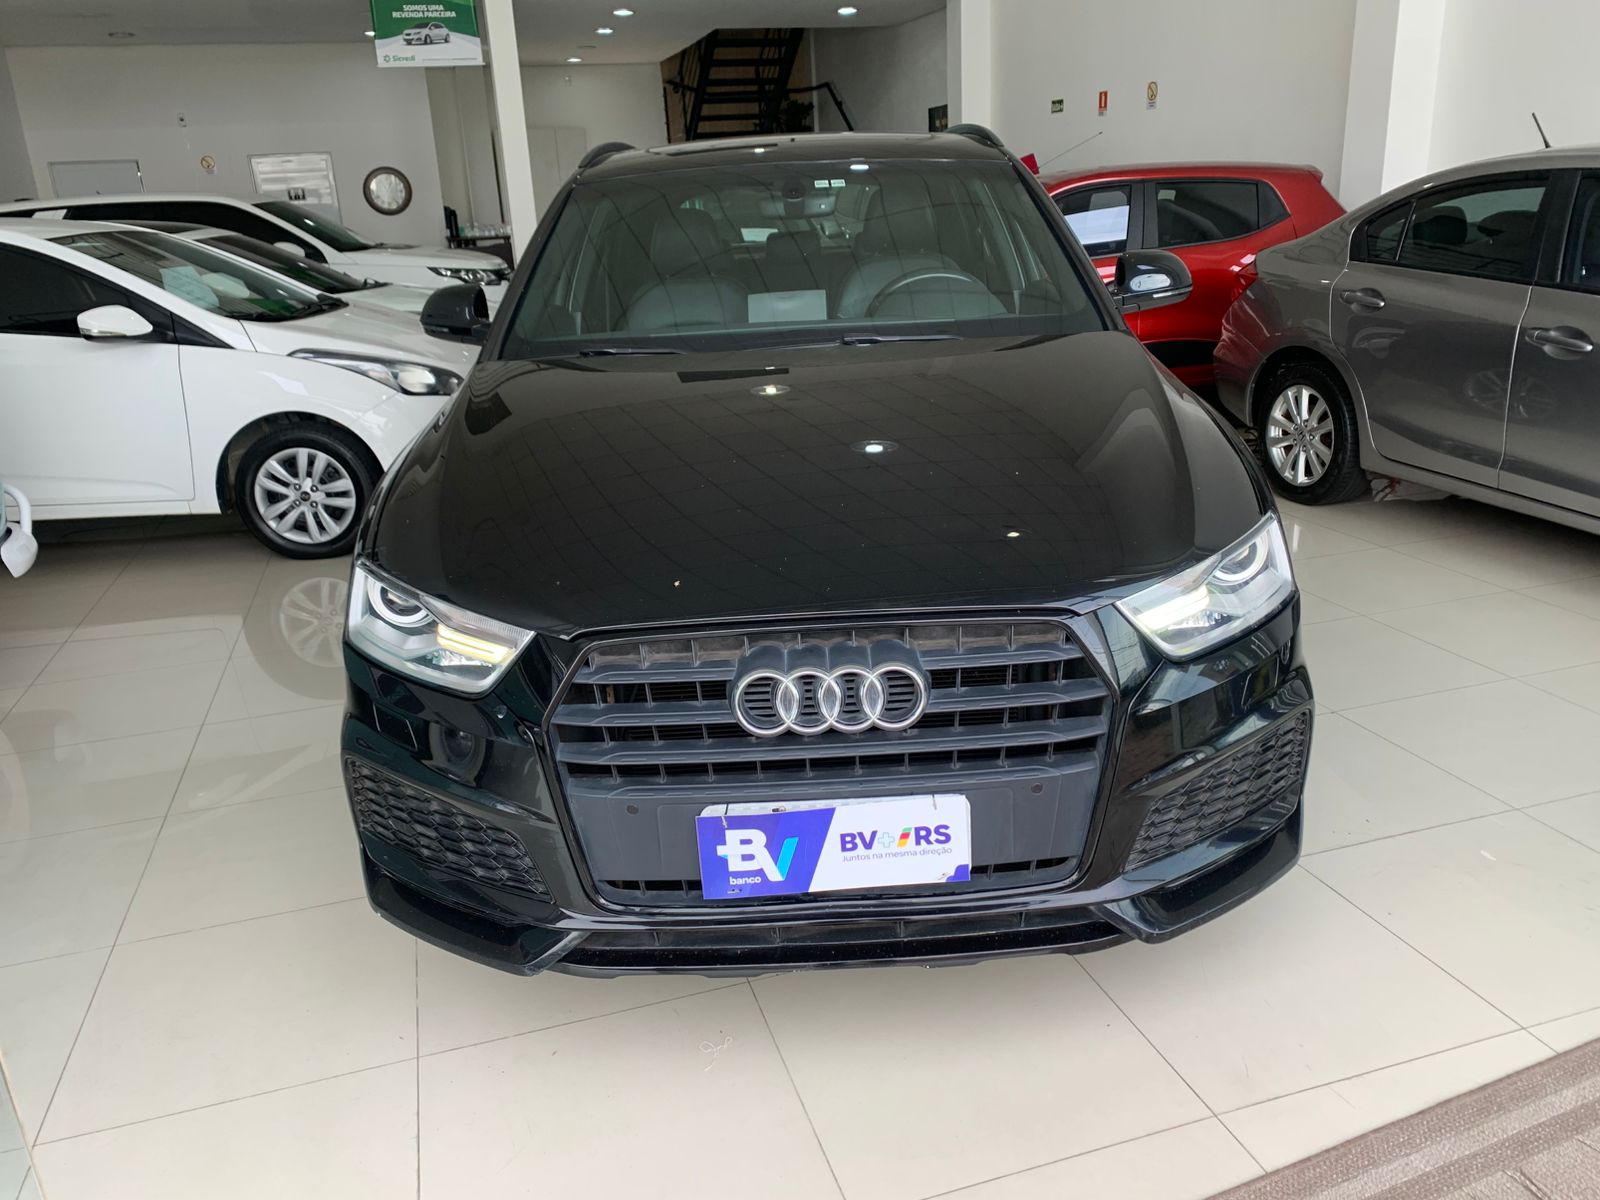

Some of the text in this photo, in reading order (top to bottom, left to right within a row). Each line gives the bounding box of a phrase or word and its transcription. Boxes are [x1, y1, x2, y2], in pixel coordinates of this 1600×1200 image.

[392, 54, 416, 62] Sicredi
[717, 828, 799, 881] BV
[885, 850, 917, 858] mesma
[919, 847, 953, 857] direção
[729, 876, 762, 885] banco
